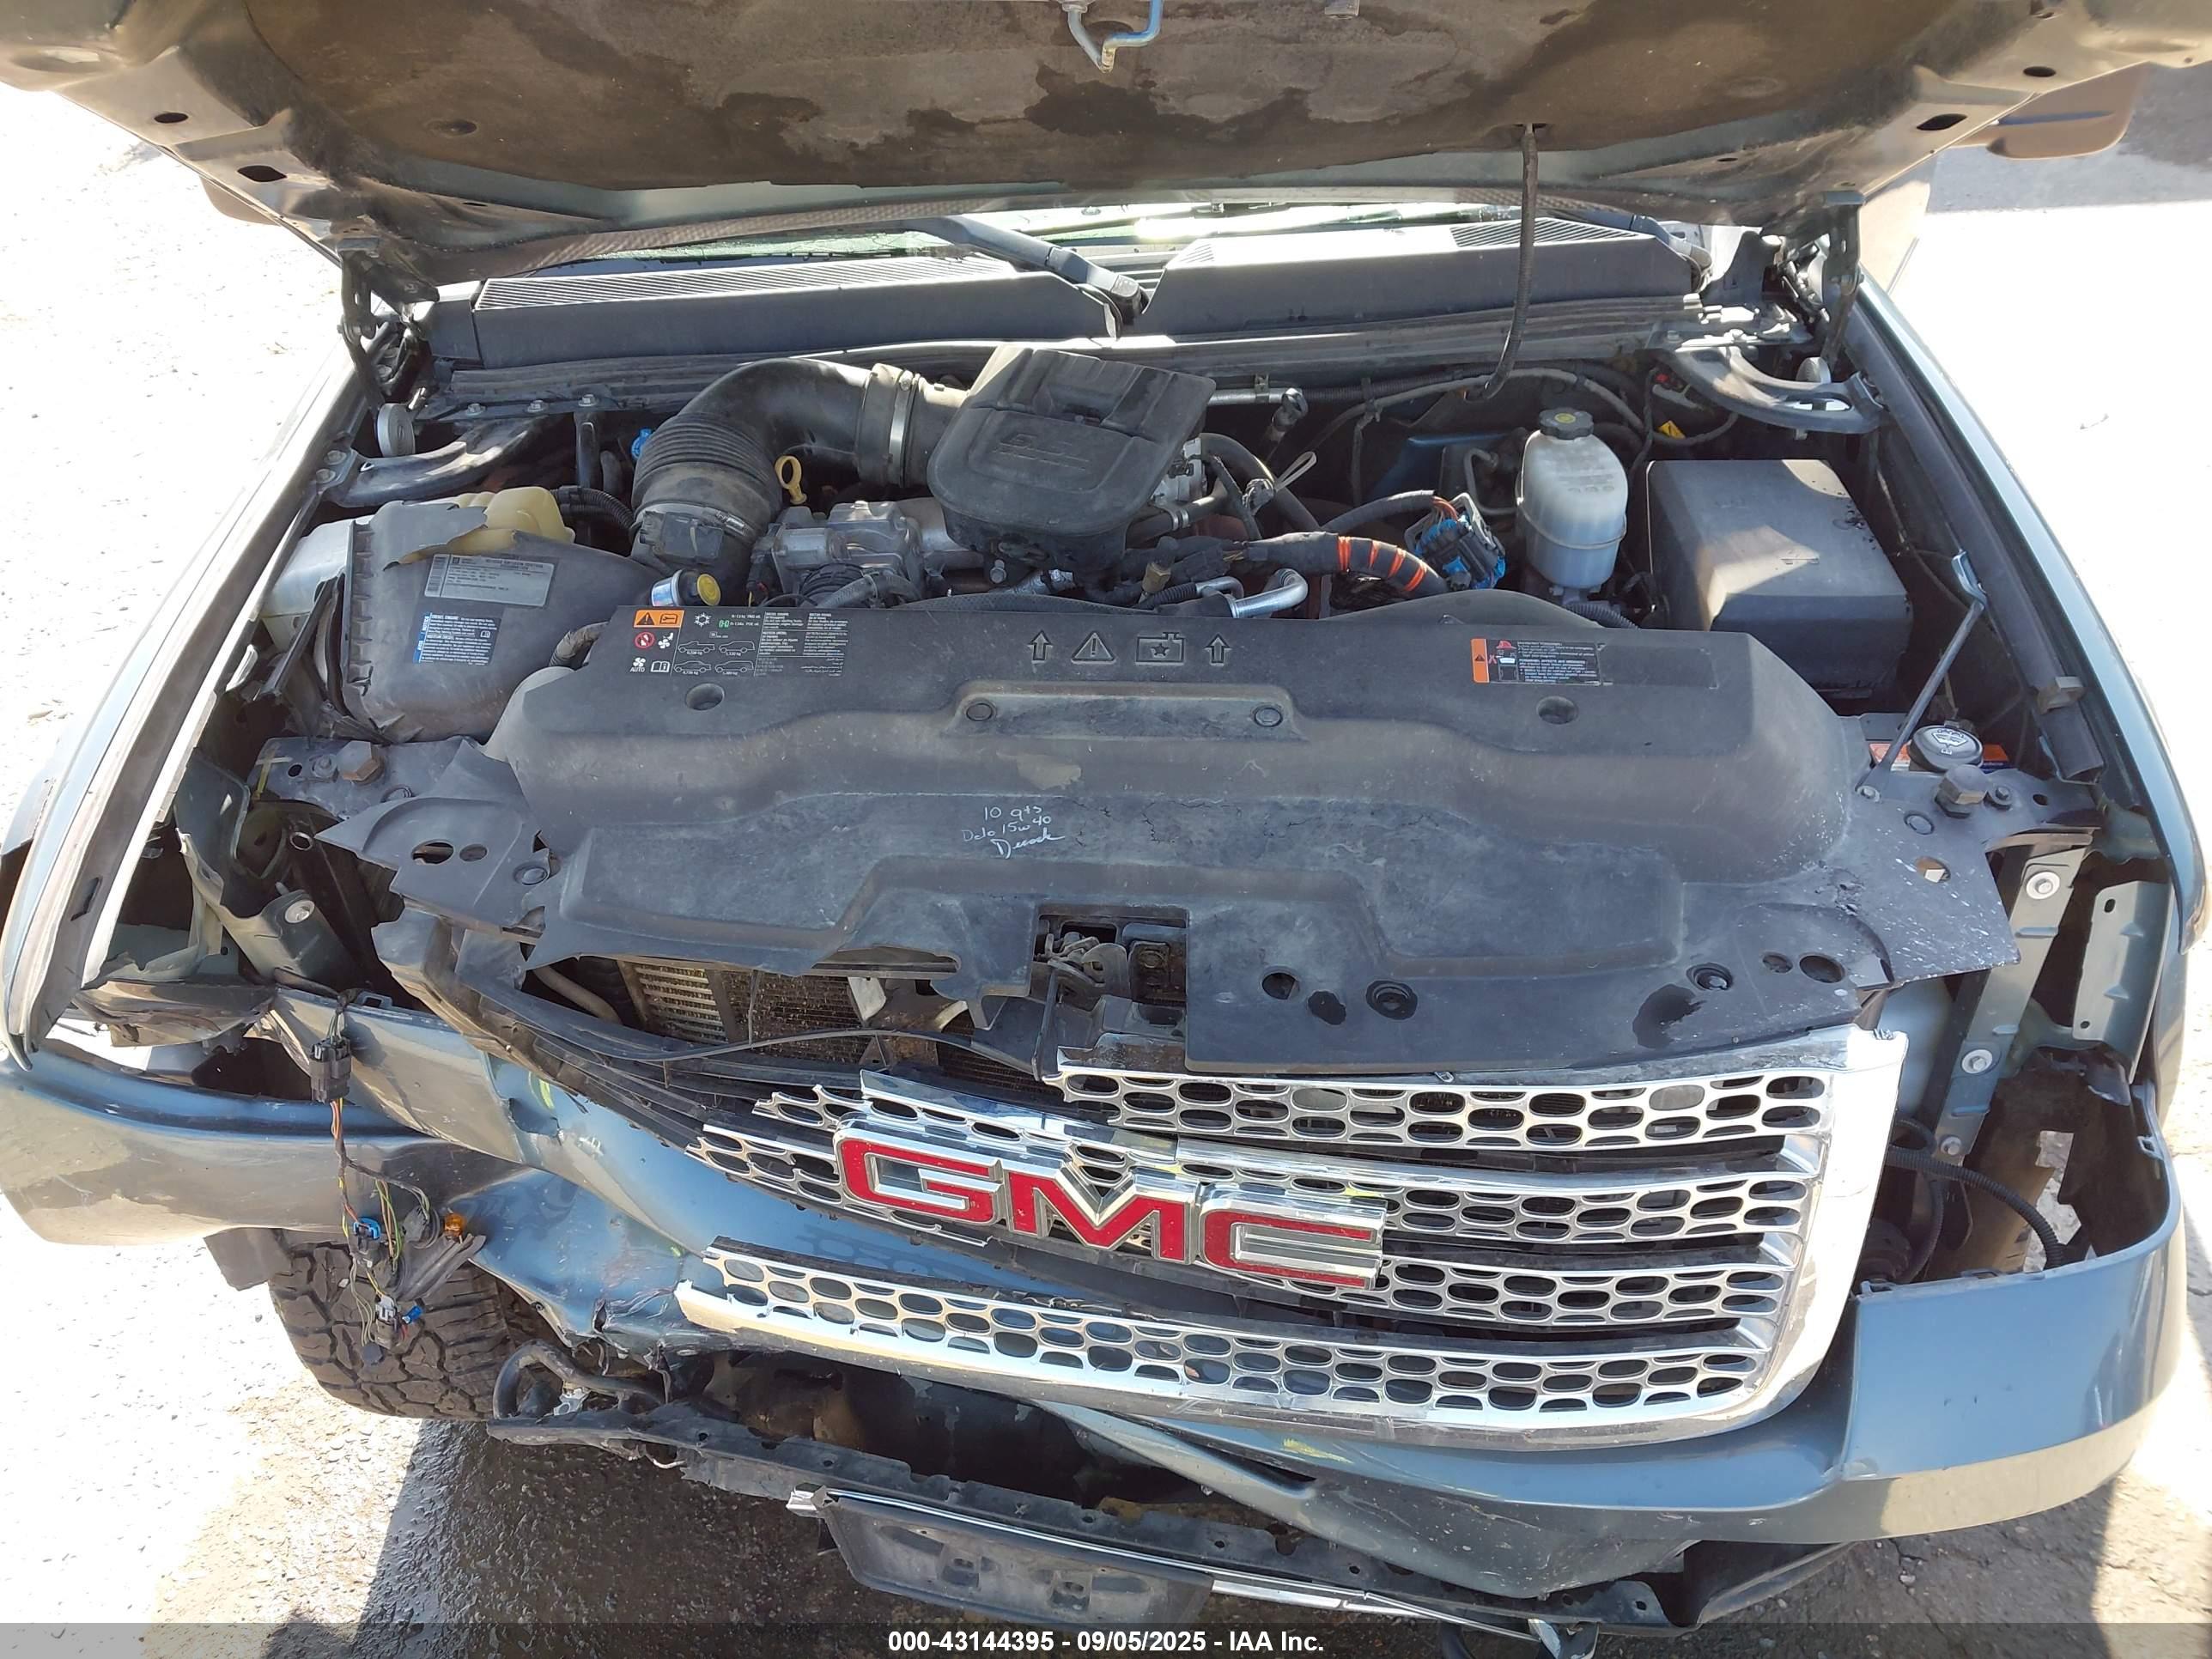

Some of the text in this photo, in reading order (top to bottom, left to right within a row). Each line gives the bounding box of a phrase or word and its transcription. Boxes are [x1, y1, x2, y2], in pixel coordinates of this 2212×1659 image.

[984, 806, 1002, 821] 10
[1032, 816, 1052, 826] 40
[833, 1119, 1386, 1290] GMC
